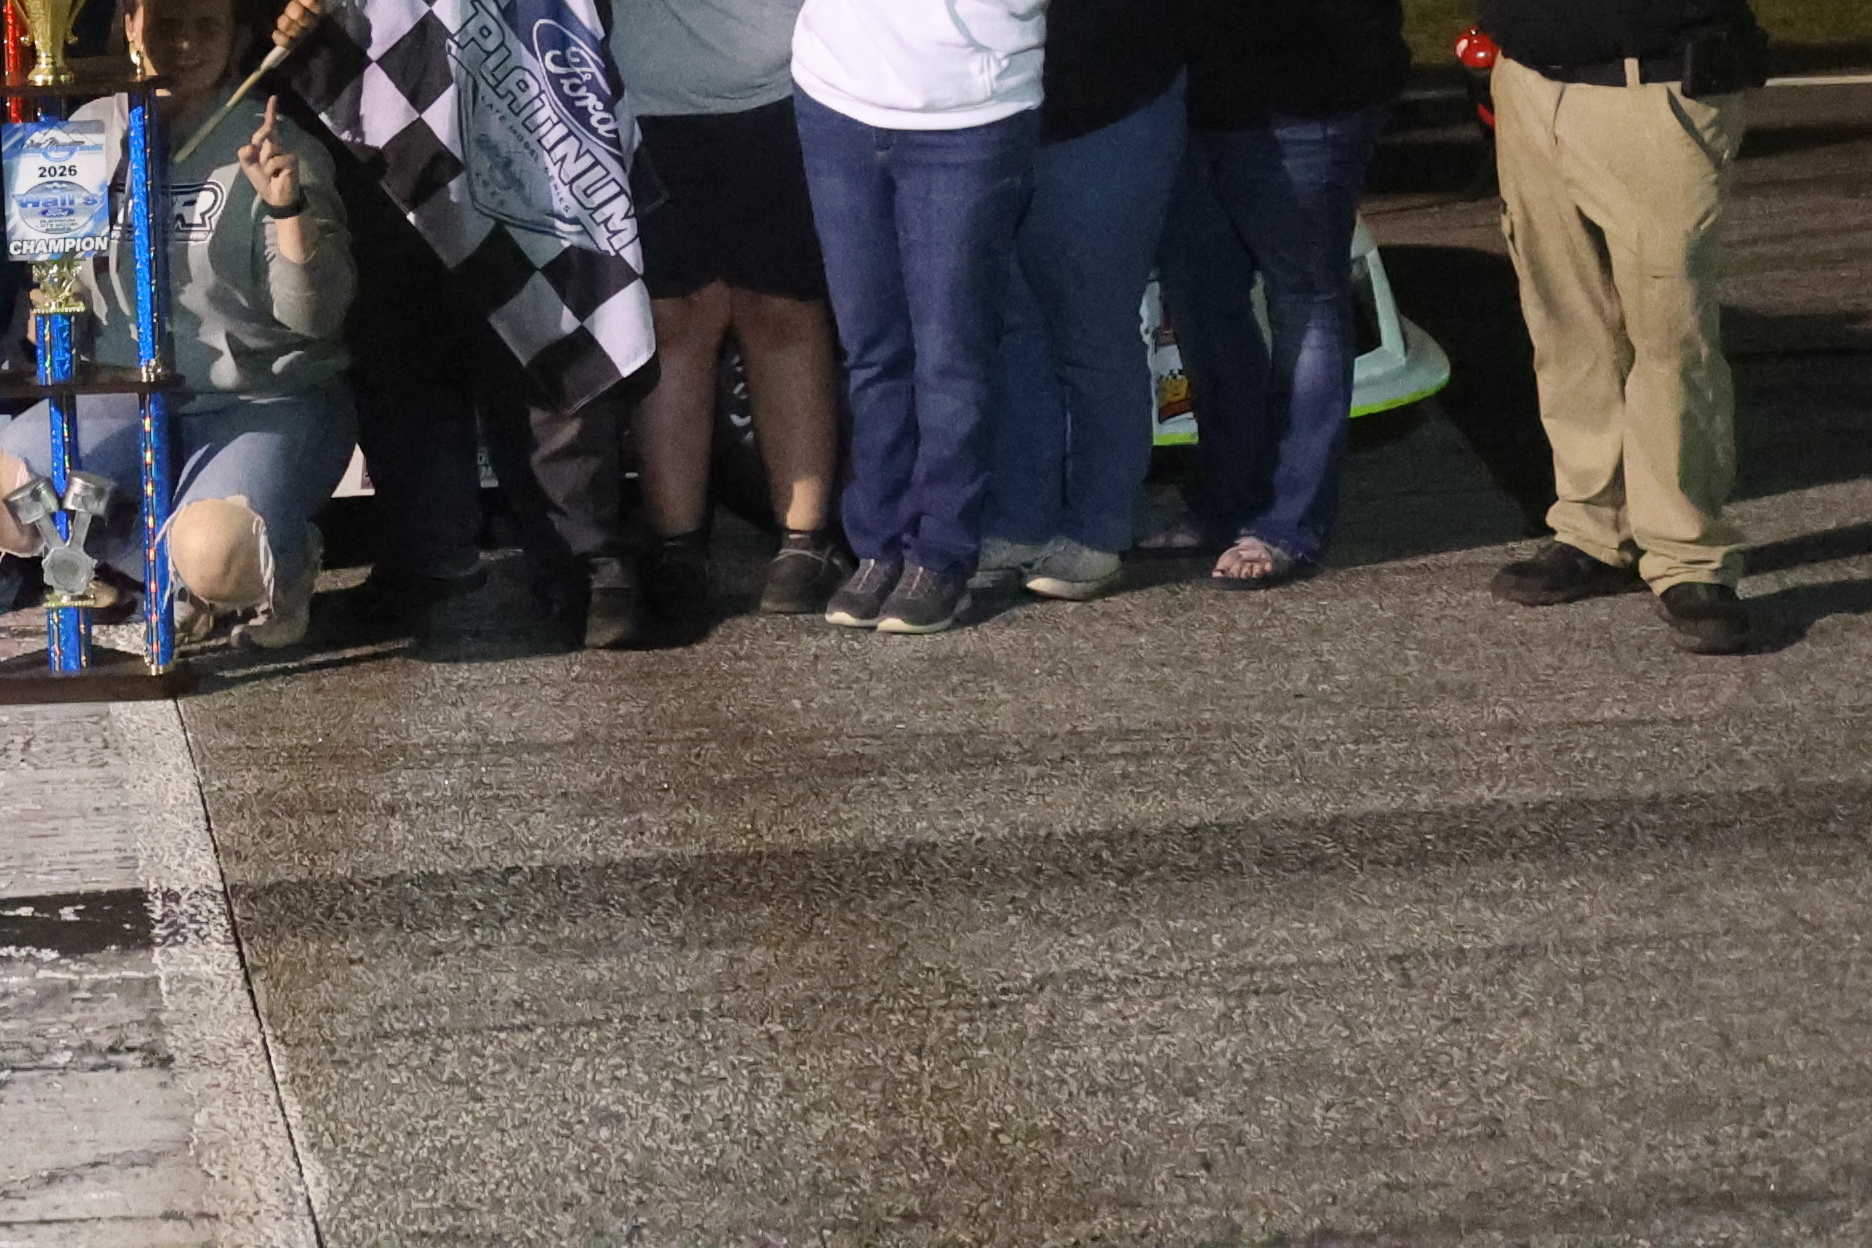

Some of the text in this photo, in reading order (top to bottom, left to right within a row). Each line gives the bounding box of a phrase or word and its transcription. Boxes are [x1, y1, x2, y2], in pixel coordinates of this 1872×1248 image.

[543, 46, 619, 141] Ford
[37, 165, 79, 179] 2026
[8, 235, 109, 256] CHAMPION
